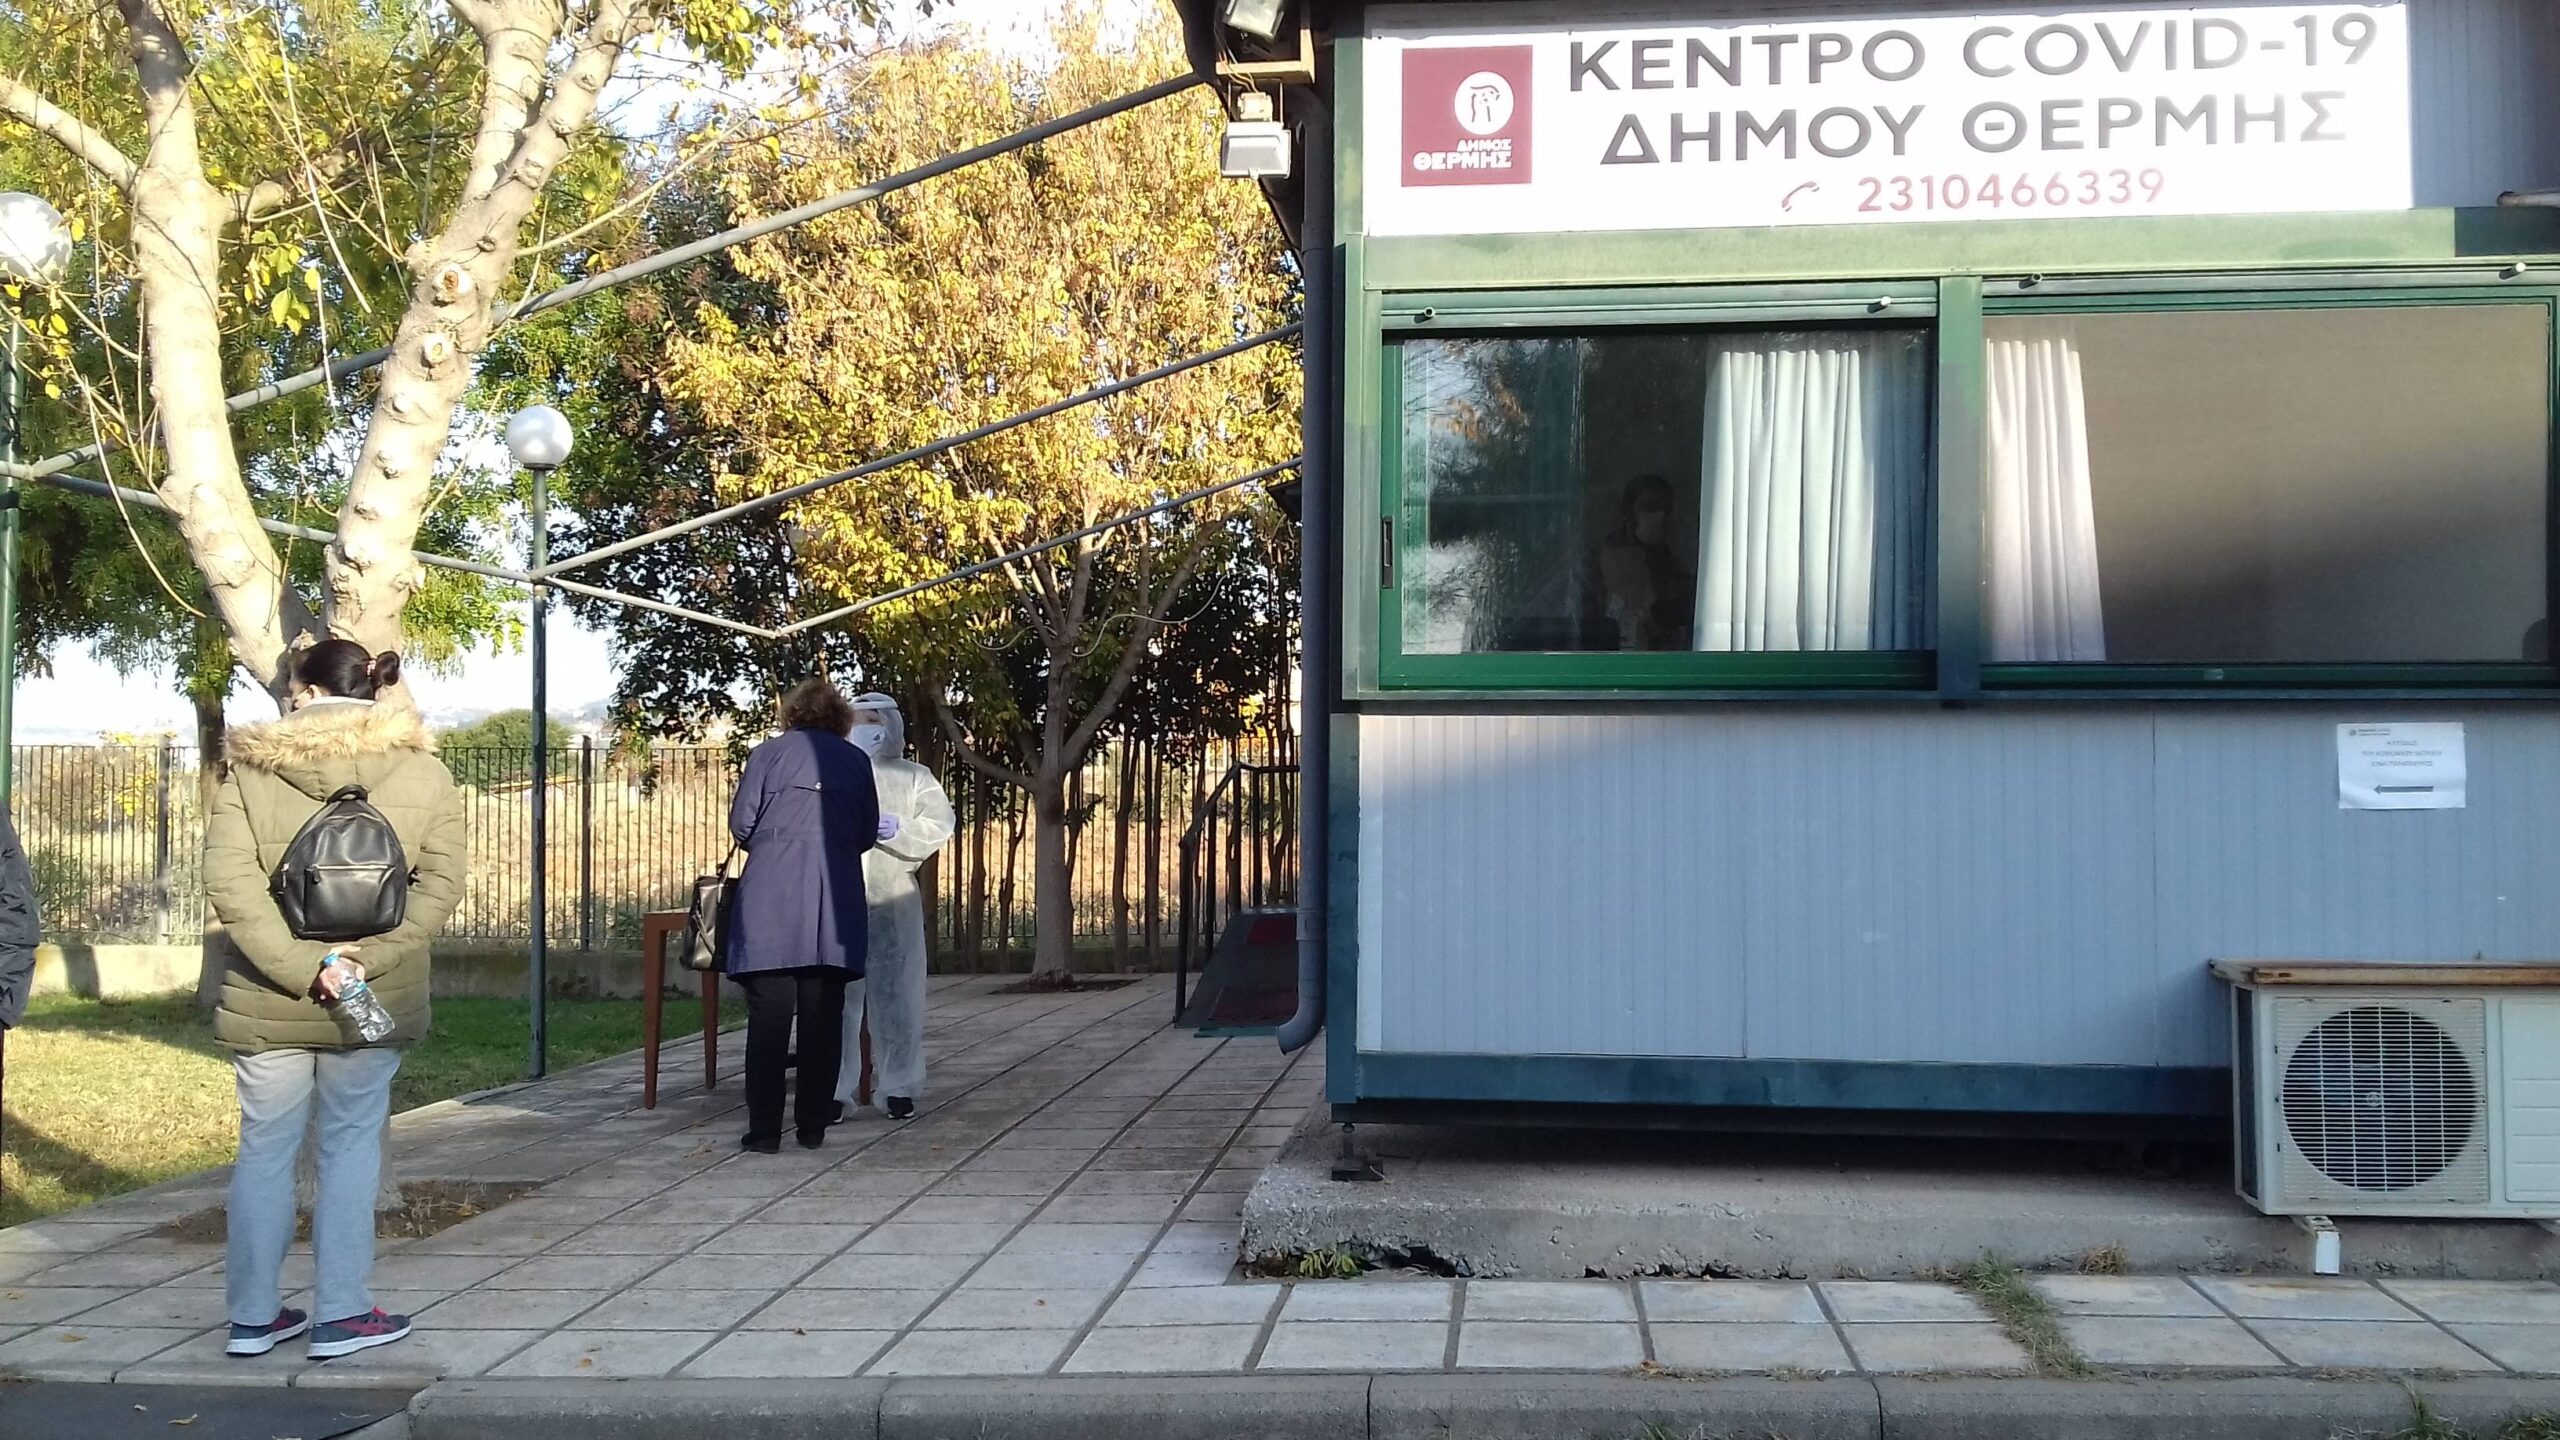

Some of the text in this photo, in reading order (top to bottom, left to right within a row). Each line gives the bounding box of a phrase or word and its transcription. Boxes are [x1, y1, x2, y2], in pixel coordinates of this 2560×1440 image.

[1570, 11, 2378, 92] ΚΕΝΤΡΟ COVID-19
[1457, 138, 1512, 152] ΔΗΜΟΣ
[1600, 90, 2346, 166] ΔΗΜΟΥ ΘΕΡΜΗΣ
[1413, 151, 1512, 171] ΘΕΡΜΗΣ
[1856, 167, 2165, 214] 2310466339
